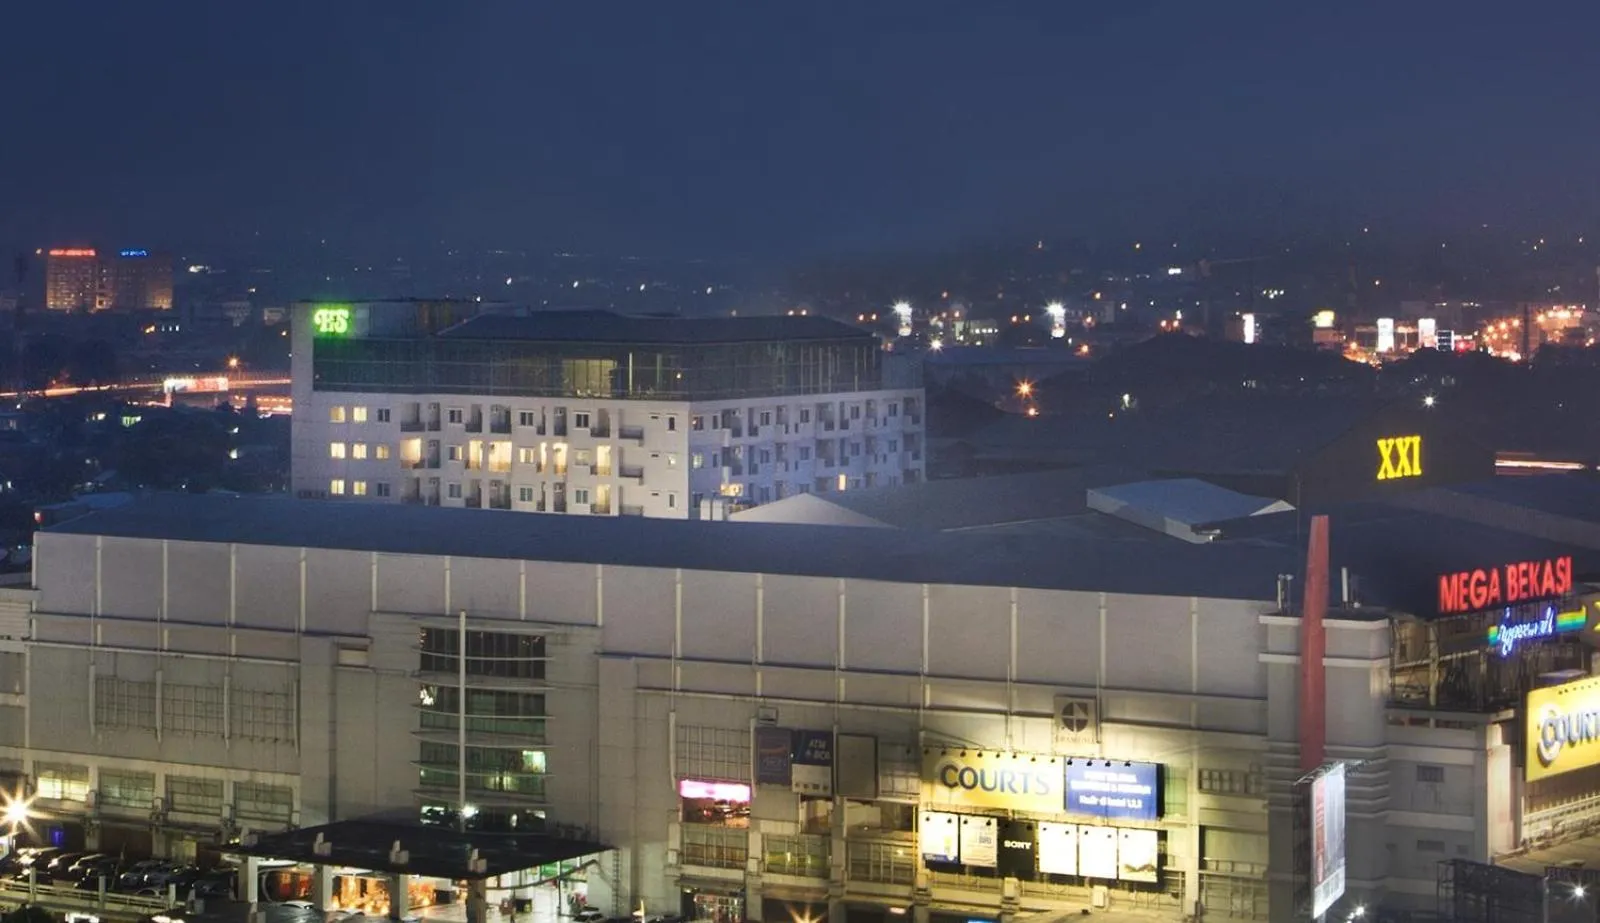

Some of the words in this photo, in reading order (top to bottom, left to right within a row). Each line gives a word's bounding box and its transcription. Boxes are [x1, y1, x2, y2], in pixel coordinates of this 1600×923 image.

[1376, 435, 1422, 480] XXI
[1439, 568, 1501, 613] MEGA
[1506, 556, 1572, 602] BEKASI
[940, 763, 1050, 796] COURTS
[1004, 839, 1032, 850] SONY
